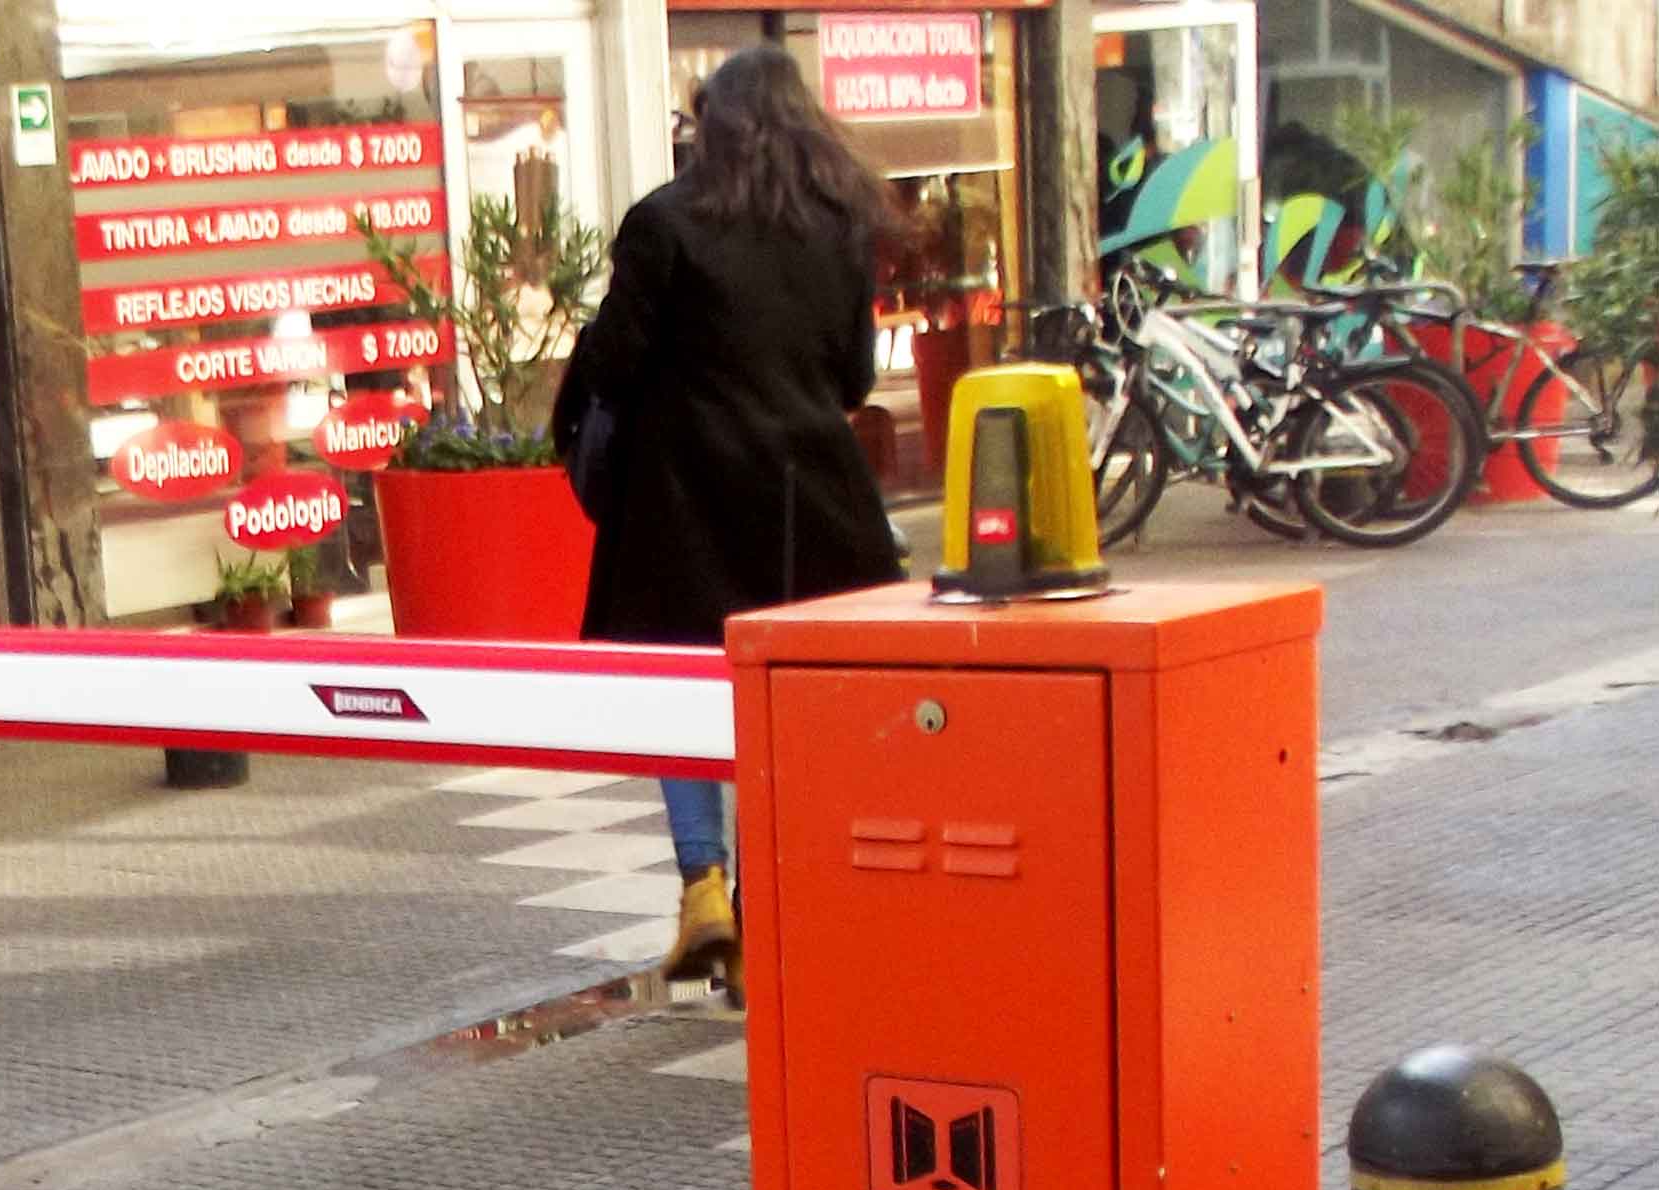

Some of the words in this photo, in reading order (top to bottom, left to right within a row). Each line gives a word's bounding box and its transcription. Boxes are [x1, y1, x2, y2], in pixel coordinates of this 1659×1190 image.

[928, 22, 974, 56] TOTAL
[835, 73, 888, 111] HASTA
[70, 146, 150, 183] AVADO
[169, 140, 277, 177] BRUSHING
[285, 138, 341, 168] desde
[348, 133, 363, 168] $
[370, 133, 422, 164] 7.000
[100, 216, 190, 251] TINTURA
[287, 203, 346, 236] desde
[115, 284, 225, 325] REFLEJOS
[227, 278, 290, 313] VISOS
[293, 272, 375, 307] MECHAS
[176, 348, 253, 383] CORTE
[361, 333, 378, 364] $
[386, 329, 439, 359] 7.000
[326, 417, 410, 453] Manicu
[128, 439, 230, 488] Depilación
[229, 490, 343, 538] Podología
